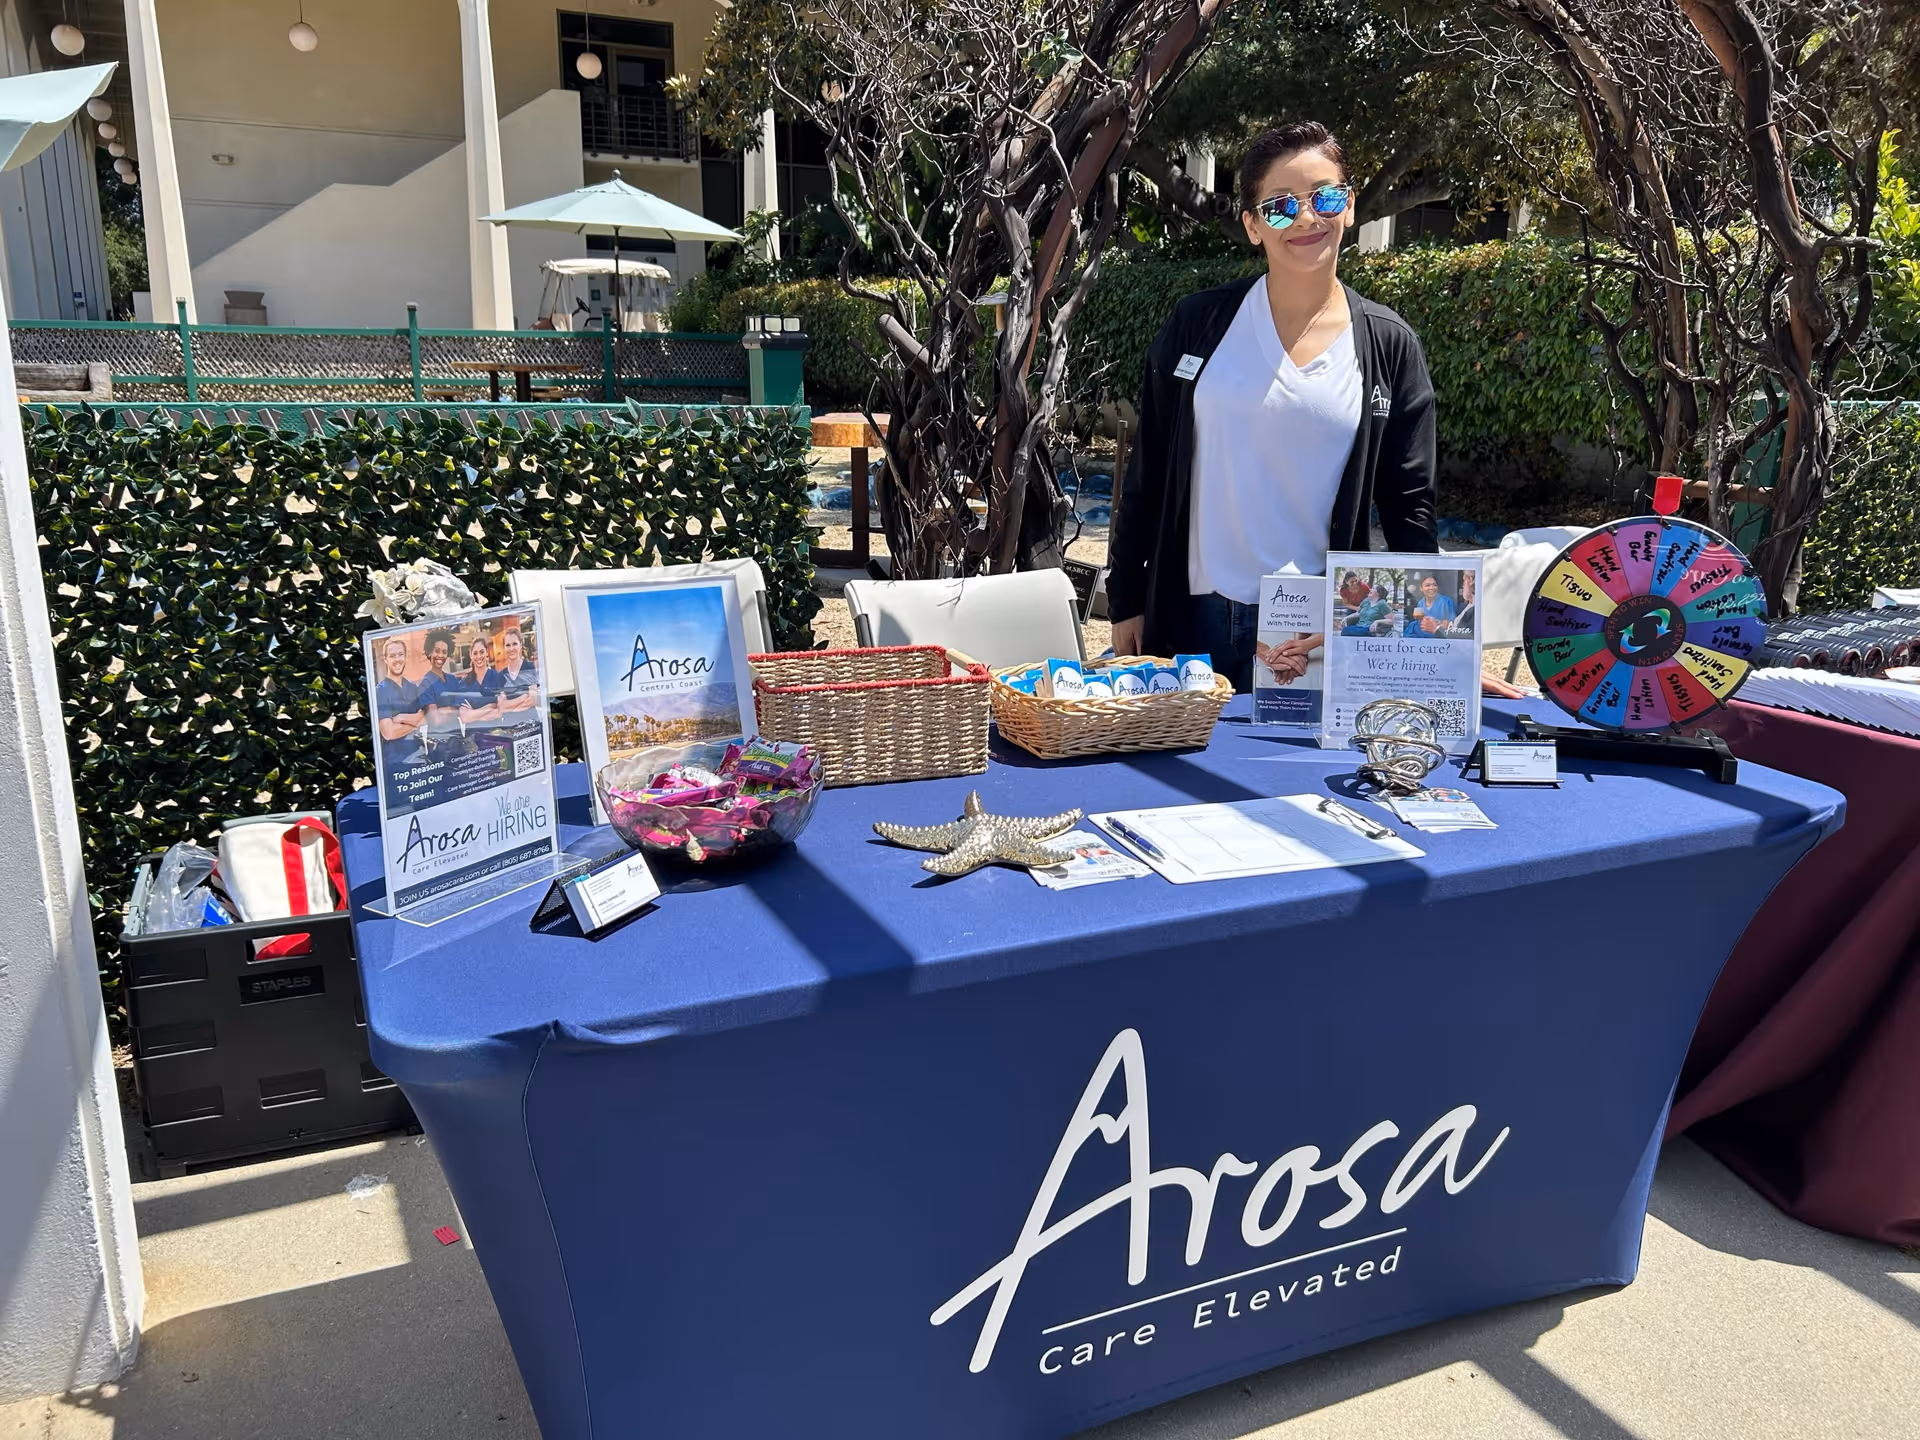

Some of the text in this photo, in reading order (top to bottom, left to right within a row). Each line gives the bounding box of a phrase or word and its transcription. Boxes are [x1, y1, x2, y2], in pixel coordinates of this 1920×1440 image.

[1594, 546, 1620, 572] Hand
[1678, 540, 1700, 568] Hand
[1071, 566, 1090, 576] SBCC
[1270, 584, 1310, 605] Arosa
[1560, 574, 1592, 601] Tissues
[1445, 621, 1472, 634] Arosa
[1356, 640, 1451, 655] Heart for care?
[1554, 648, 1575, 663] Bar
[620, 634, 714, 692] Arosa
[1368, 658, 1438, 675] We're hiring.
[1055, 671, 1084, 690] Arosa
[1182, 666, 1213, 683] Arosa
[1555, 668, 1578, 688] Hand
[1572, 662, 1605, 691] Lotion
[1695, 670, 1725, 690] Hand
[640, 683, 674, 692] Central
[1117, 681, 1146, 696] Arosa
[1151, 679, 1179, 694] Arosa
[1641, 679, 1654, 708] Lotion
[1667, 673, 1694, 712] Tissues
[1587, 680, 1612, 715] Granola
[1606, 688, 1621, 708] Bar
[1630, 696, 1641, 720] Hand
[393, 760, 445, 782] Top Reasons
[397, 774, 443, 793] To Join Our
[459, 780, 477, 788] Manager
[409, 790, 435, 803] Team!
[494, 788, 530, 817] We are
[488, 805, 546, 845] HIRING
[396, 815, 481, 873] Arosa
[412, 851, 468, 874] Care Elevated
[399, 893, 417, 905] JOIN
[419, 888, 429, 897] US
[430, 870, 480, 893] arosacare.com
[481, 868, 488, 876] or
[489, 860, 501, 872] call
[502, 856, 519, 868] (805)
[520, 845, 550, 861] 687-8766
[252, 976, 312, 993] STAPLES
[930, 1027, 1510, 1373] Arosa
[1038, 1246, 1402, 1375] Care Elevated
